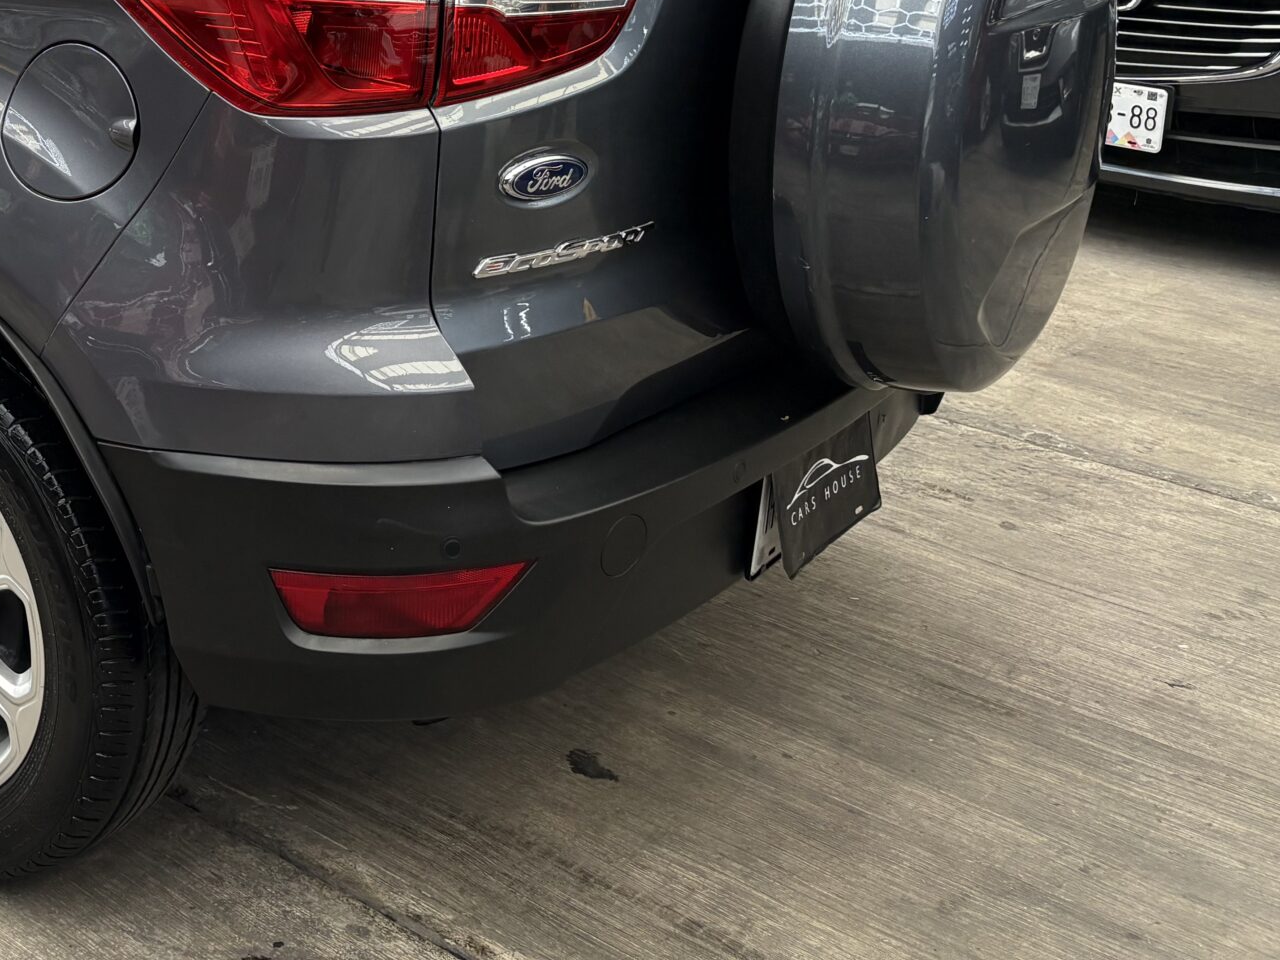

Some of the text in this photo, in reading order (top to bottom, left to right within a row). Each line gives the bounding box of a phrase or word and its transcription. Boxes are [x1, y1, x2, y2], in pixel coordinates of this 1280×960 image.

[1108, 102, 1158, 131] -88
[527, 164, 574, 193] Ford
[790, 465, 862, 526] CARS HOUSE
